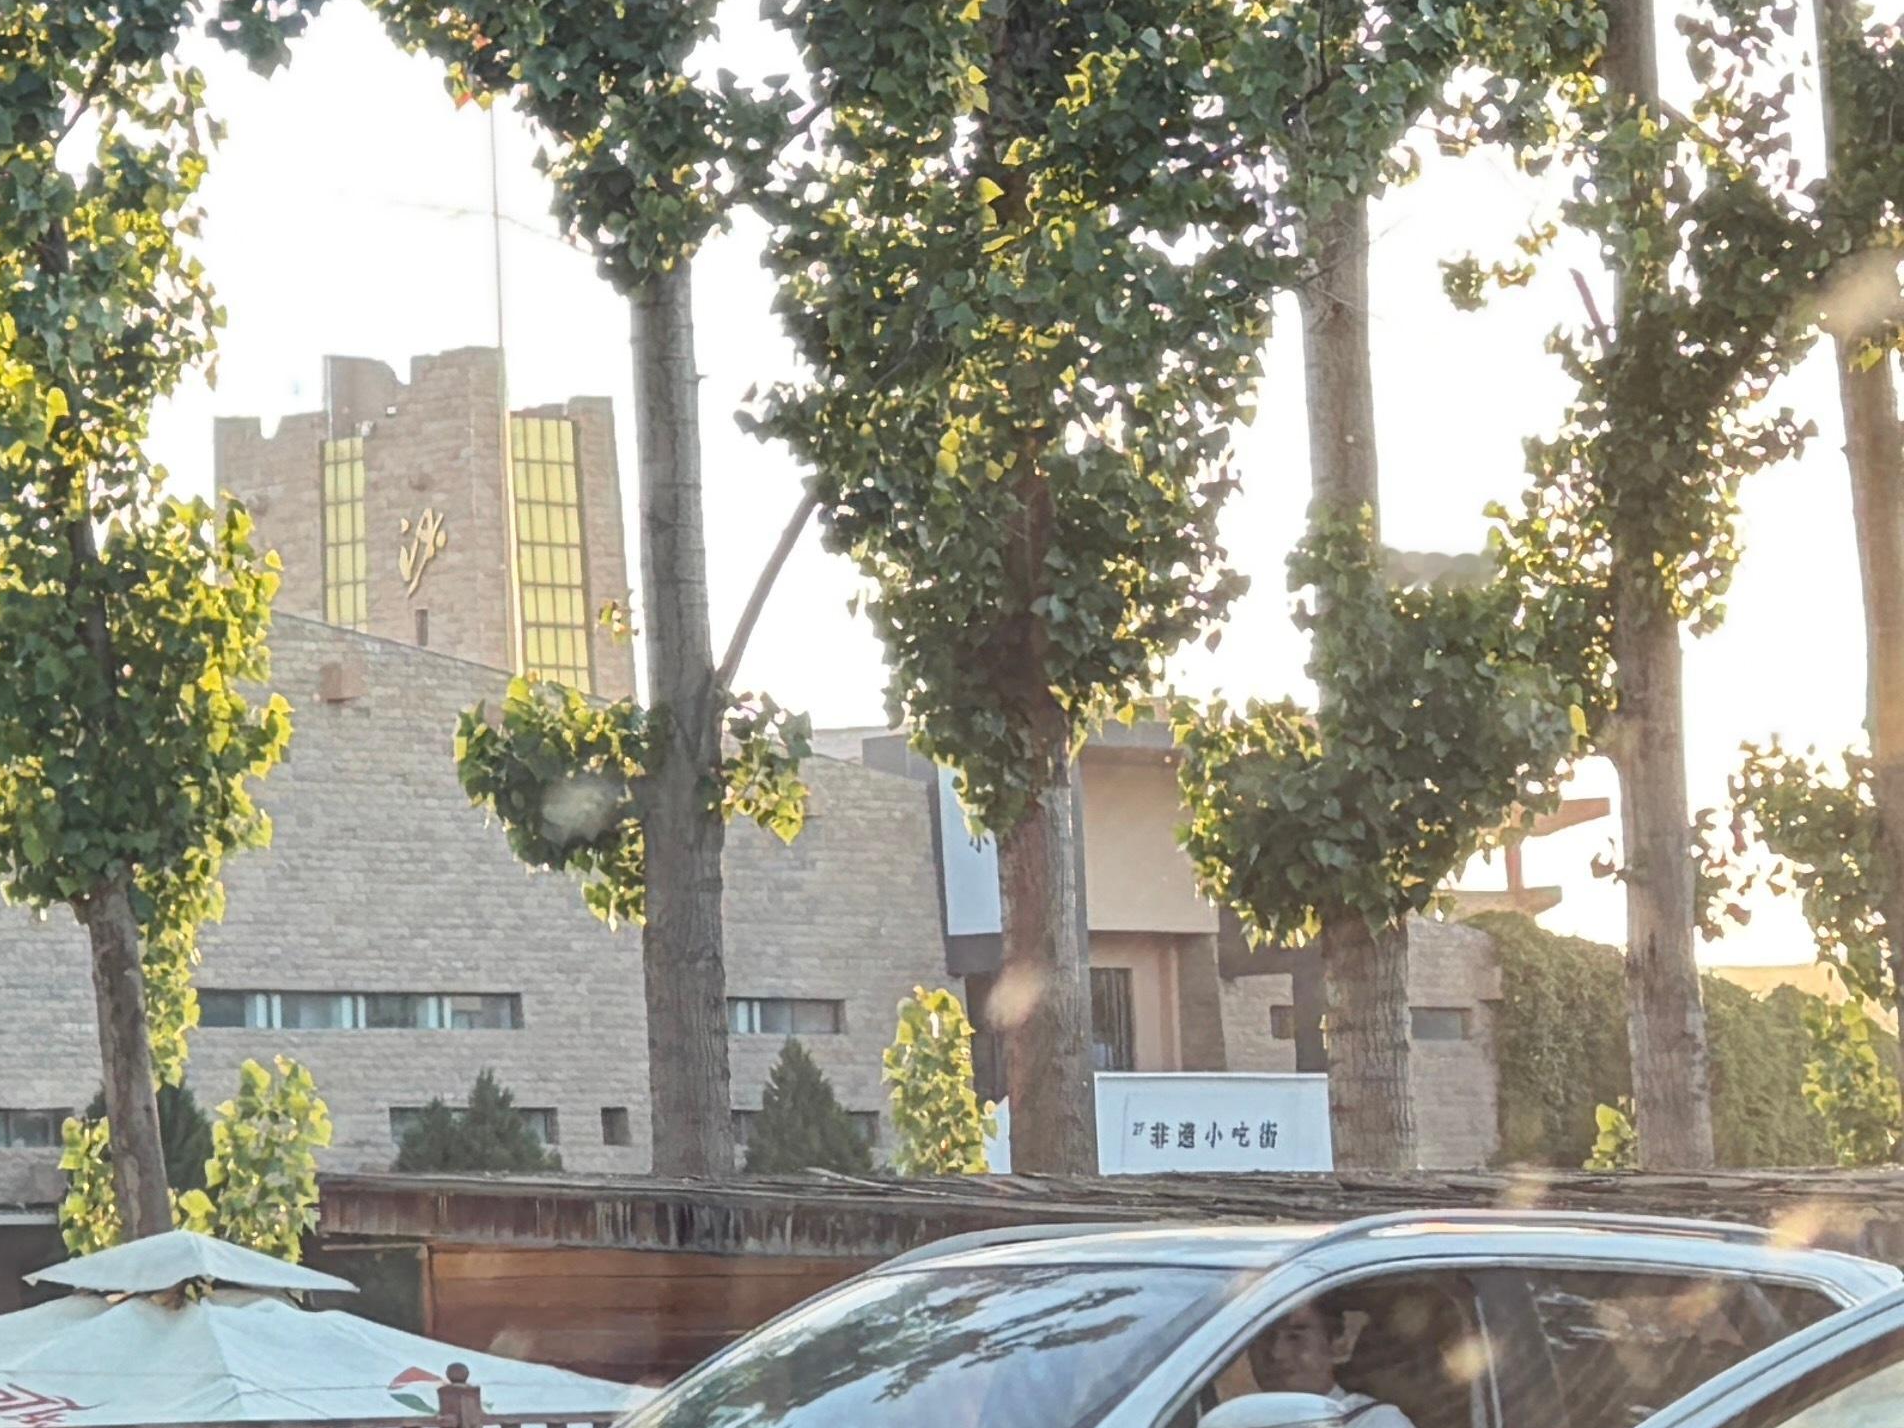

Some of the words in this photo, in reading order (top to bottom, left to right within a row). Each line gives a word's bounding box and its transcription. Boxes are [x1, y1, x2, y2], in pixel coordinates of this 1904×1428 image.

[1150, 1121, 1279, 1149] 非遗小吃街
